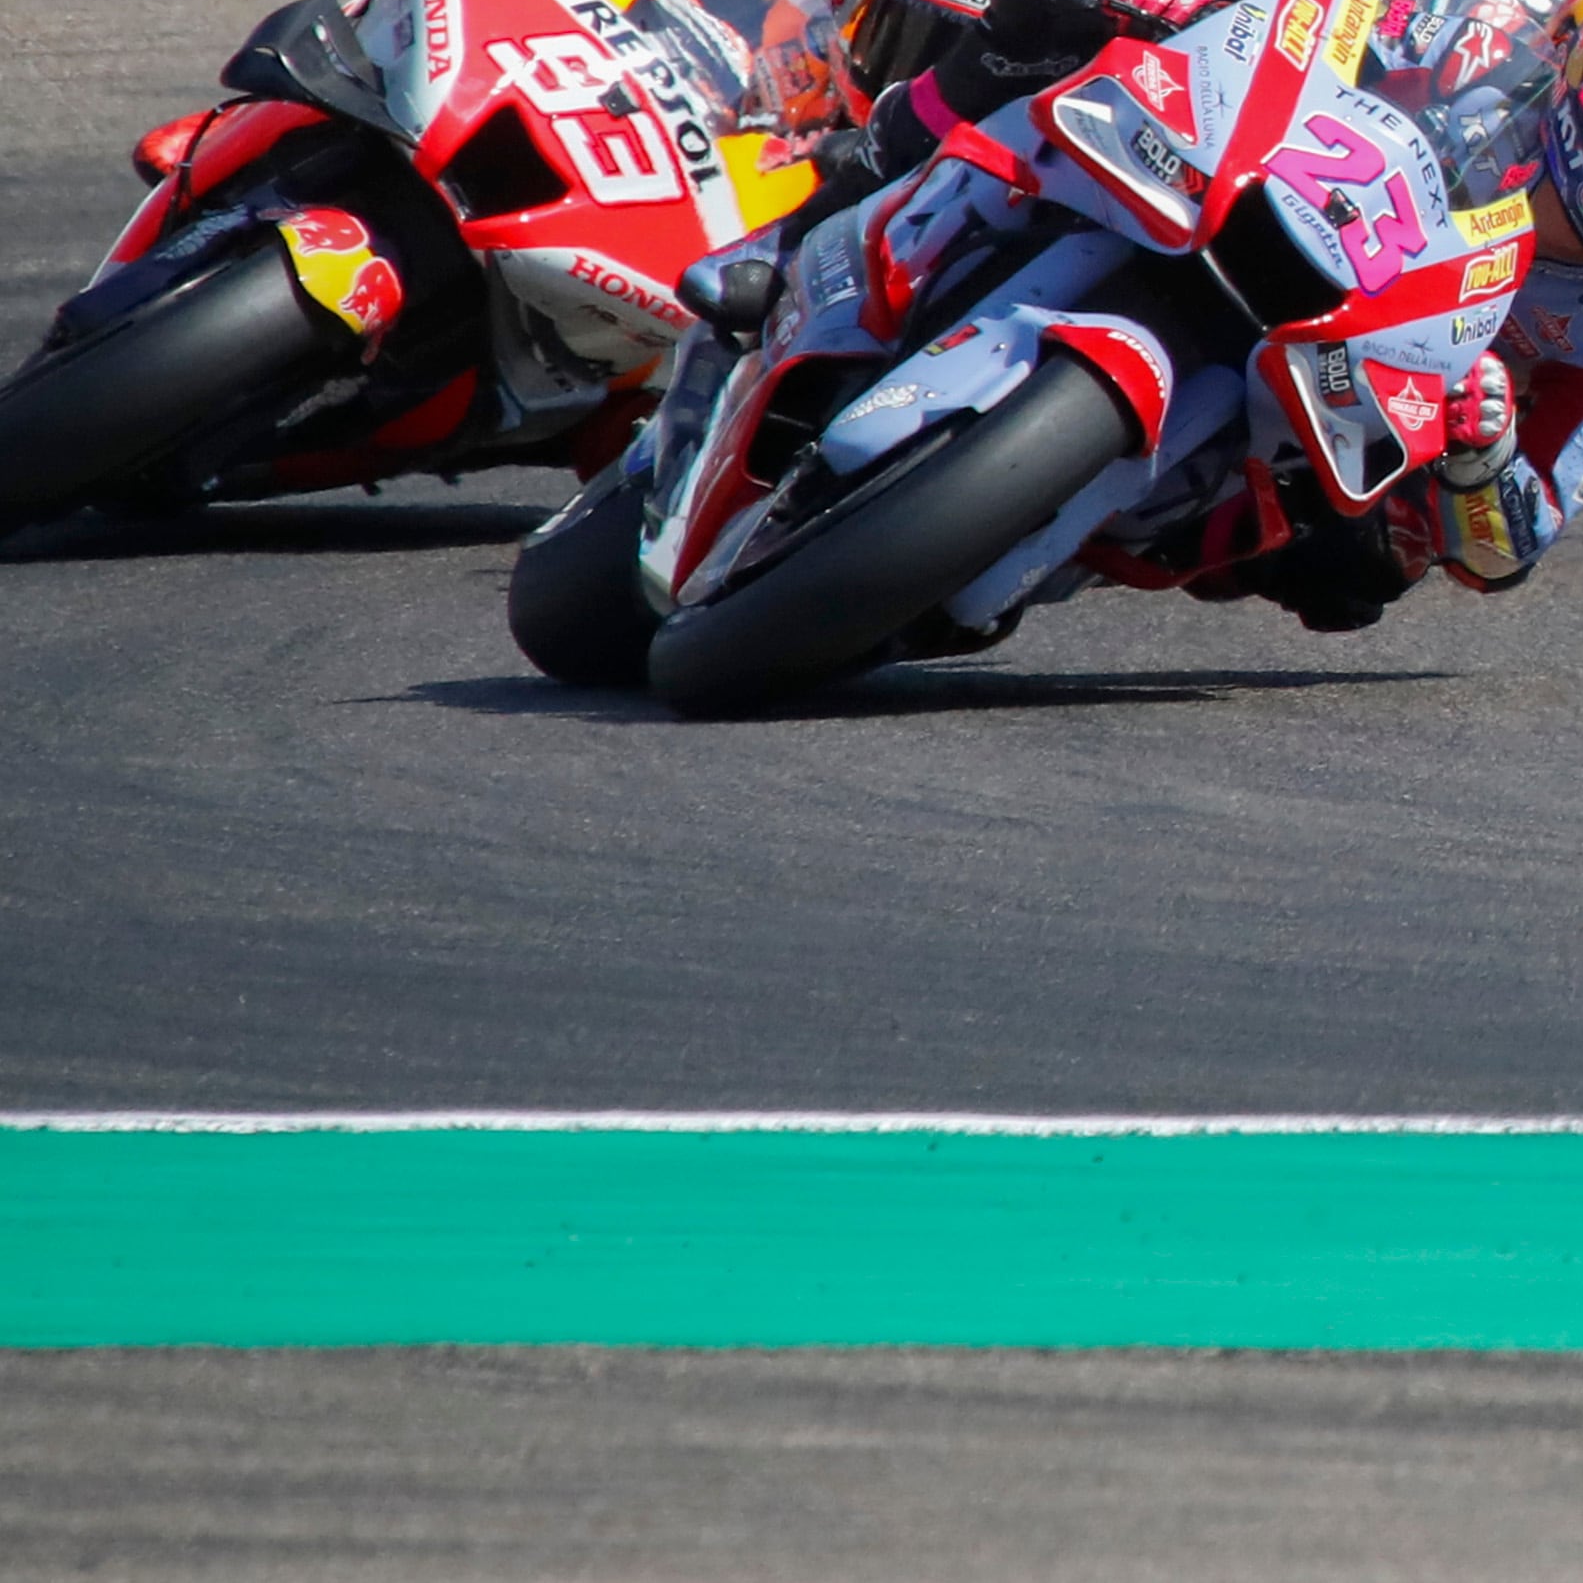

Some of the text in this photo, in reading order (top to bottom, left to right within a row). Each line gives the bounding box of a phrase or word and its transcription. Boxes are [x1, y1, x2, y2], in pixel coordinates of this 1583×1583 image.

[1223, 2, 1267, 64] Unibat
[486, 30, 686, 206] 93
[570, 0, 722, 193] REPSOL
[1335, 83, 1449, 230] THE NEXT
[1259, 110, 1429, 298] 23
[1469, 201, 1526, 238] Antangin
[1107, 329, 1169, 399] DUCATI
[1450, 312, 1499, 346] Unibat
[1328, 348, 1350, 393] BOLD
